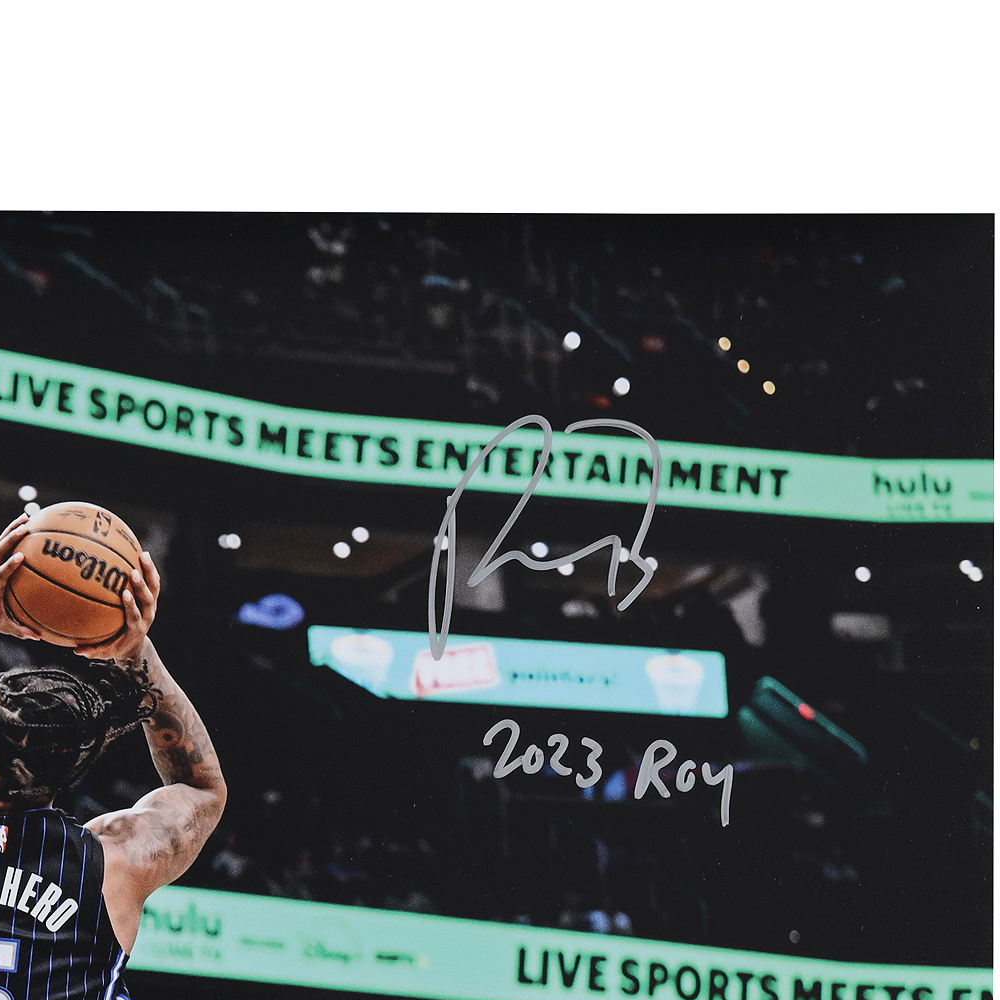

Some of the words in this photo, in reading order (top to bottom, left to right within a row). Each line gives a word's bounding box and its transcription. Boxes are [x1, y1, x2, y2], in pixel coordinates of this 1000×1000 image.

[90, 388, 245, 448] SPORTS
[259, 421, 400, 467] MEETS
[416, 439, 793, 500] ENTERTAINMENT
[870, 470, 951, 495] hulu
[41, 537, 128, 597] Wilson
[483, 718, 604, 789] 2023
[517, 947, 607, 992] LIVE
